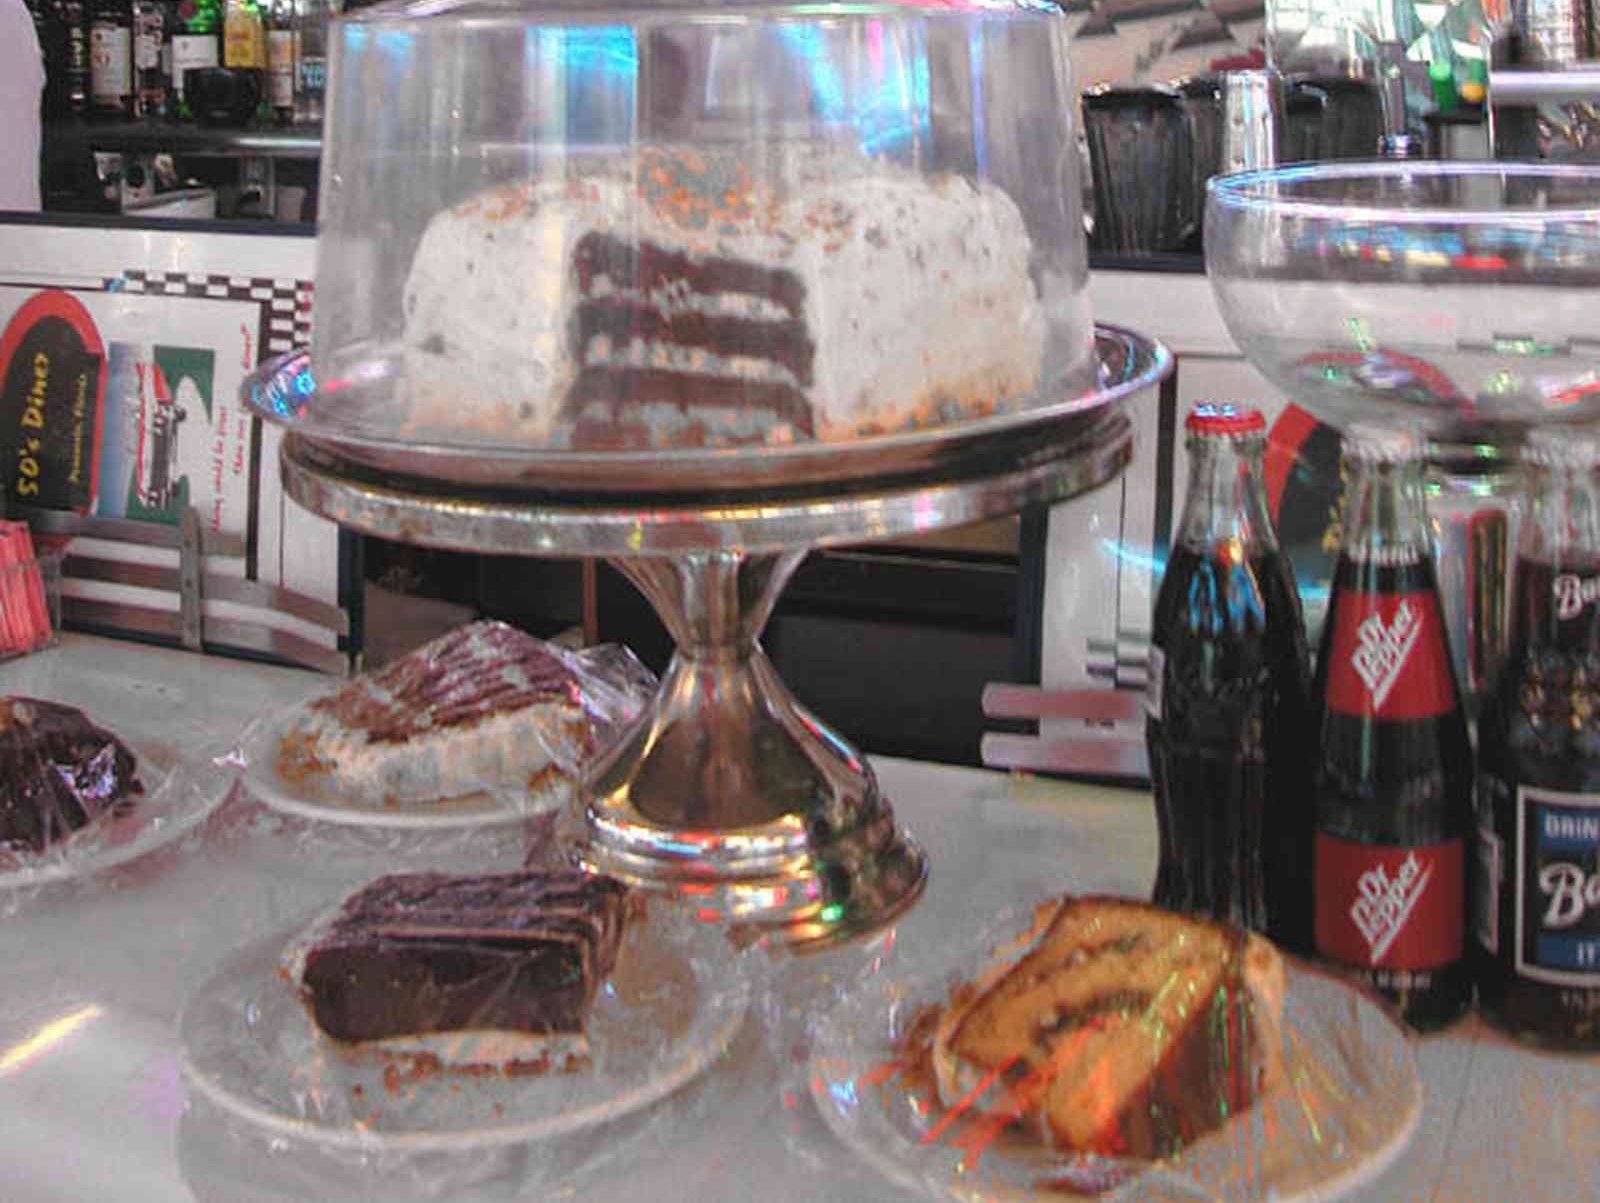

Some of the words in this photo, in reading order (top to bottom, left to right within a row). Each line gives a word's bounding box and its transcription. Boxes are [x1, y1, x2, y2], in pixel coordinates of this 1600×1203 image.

[20, 351, 50, 429] Diner
[1351, 597, 1413, 692] Pepper
[1350, 850, 1421, 947] Pepper
